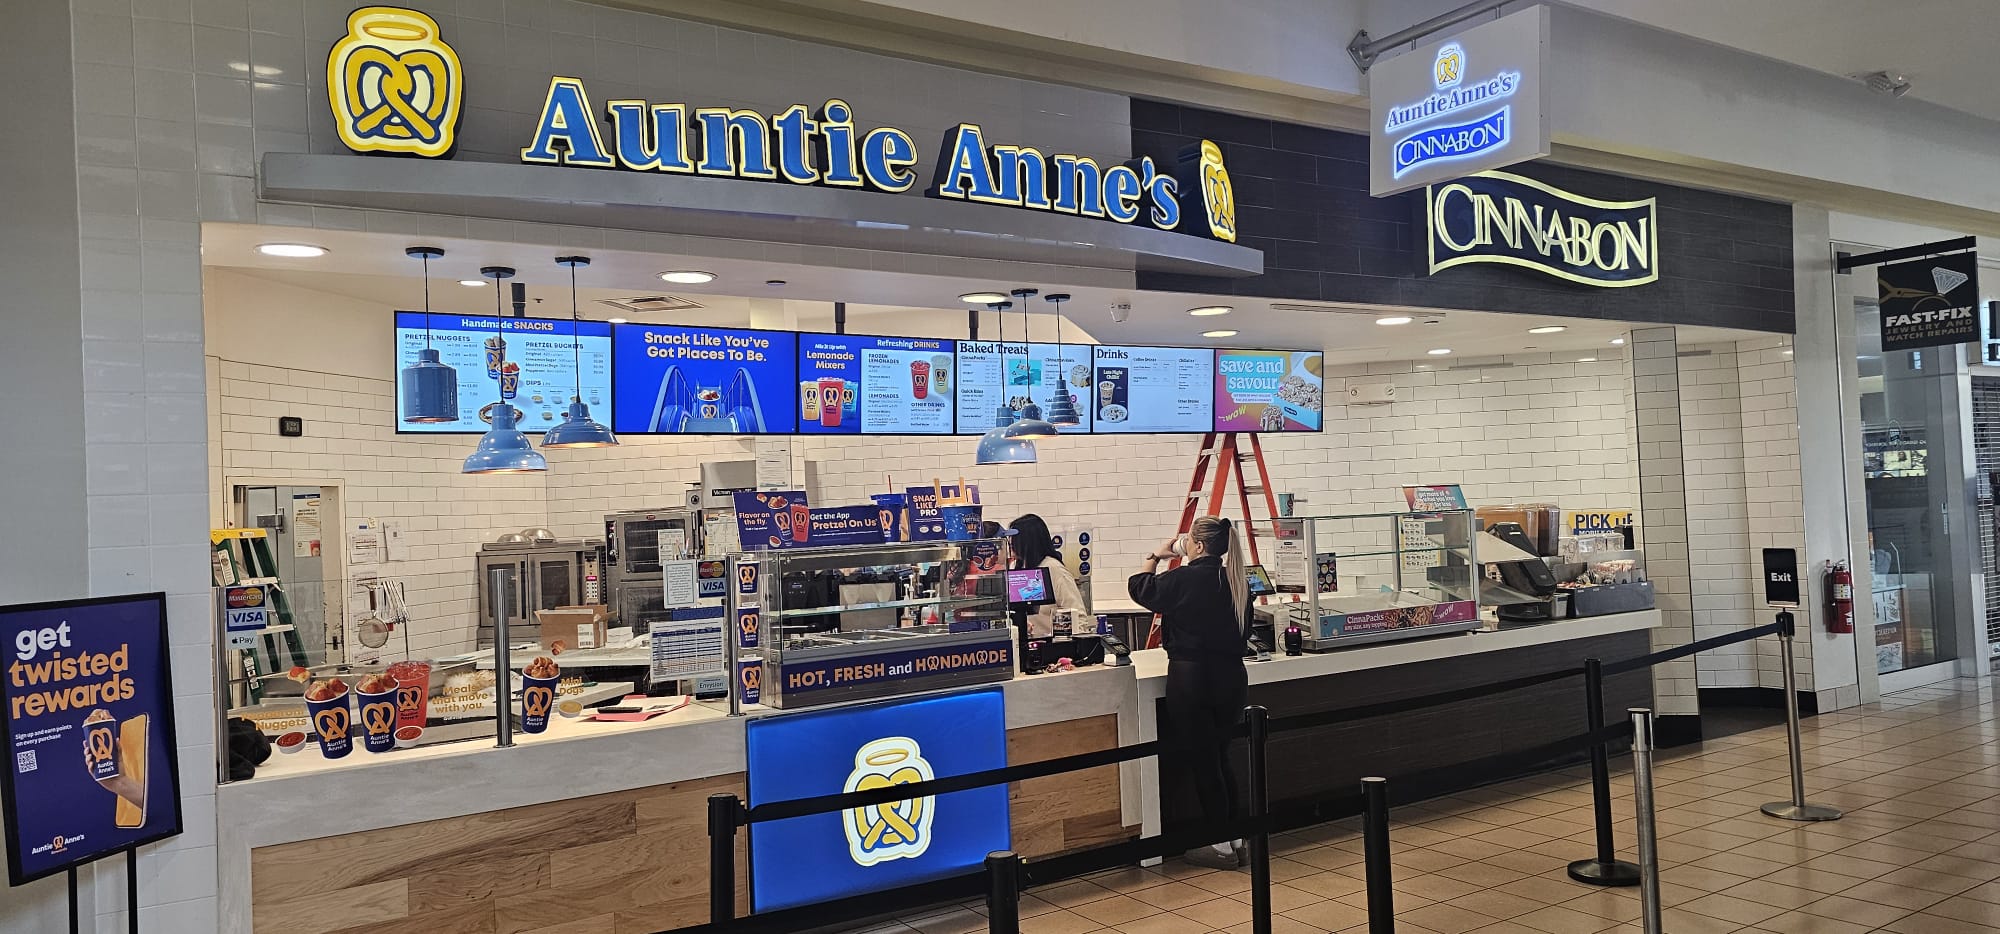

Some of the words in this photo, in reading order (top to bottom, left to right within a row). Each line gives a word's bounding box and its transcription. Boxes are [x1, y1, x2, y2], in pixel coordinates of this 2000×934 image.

[1388, 95, 1447, 128] Auntie
[1448, 75, 1512, 109] Anne's
[1398, 117, 1501, 165] CINNABON
[521, 76, 918, 193] Auntie
[938, 123, 1179, 230] Anne's
[1434, 183, 1647, 270] CINNABON
[461, 319, 513, 329] Handmade
[513, 321, 553, 331] SNACKS
[1885, 323, 1941, 335] JEWELRY
[1945, 319, 1973, 328] AND
[405, 333, 436, 341] PRETZL
[644, 331, 690, 345] Snack
[693, 334, 721, 346] Like
[724, 335, 769, 348] You've
[1886, 332, 1924, 342] WATCH
[1927, 326, 1973, 337] REPAIRS
[877, 339, 914, 349] Refreshing
[914, 341, 940, 349] DRINKS
[960, 342, 994, 354] Baked
[995, 343, 1029, 355] Treats
[646, 346, 675, 359] Got
[677, 347, 725, 360] Places
[727, 349, 743, 361] To
[746, 349, 767, 362] Be.
[806, 350, 855, 361] Lemonade
[1096, 348, 1129, 359] Drinks
[815, 361, 846, 370] Mixers
[1220, 360, 1254, 373] save
[1256, 357, 1284, 373] and
[1229, 377, 1278, 390] savour
[912, 494, 936, 502] SNAC
[916, 502, 934, 510] LIKE
[836, 512, 850, 520] App
[920, 508, 938, 517] PRO
[812, 520, 847, 530] Pretzel
[848, 519, 863, 528] On
[1575, 513, 1612, 529] PICK
[1770, 571, 1792, 583] Exit
[702, 581, 725, 591] VISA
[232, 611, 264, 623] VISA
[1346, 613, 1385, 624] CinnaPacks
[15, 620, 72, 661] get
[239, 637, 254, 645] Pay
[8, 643, 129, 687] twisted
[789, 669, 831, 687] HOT,
[834, 662, 885, 681] FRESH
[888, 661, 913, 677] and
[560, 676, 583, 687] Mini
[443, 684, 479, 695] Meals
[560, 687, 585, 696] Dogs
[11, 674, 135, 720] rewards
[432, 695, 457, 705] that
[459, 693, 489, 702] move
[435, 703, 460, 714] with
[462, 703, 485, 713] you.
[255, 718, 308, 731] Nuggets
[15, 731, 27, 741] Sign
[27, 731, 34, 739] up
[34, 728, 44, 736] and
[56, 724, 73, 733] points
[23, 738, 38, 747] every
[38, 733, 62, 744] purchase
[326, 739, 347, 748] Auntie
[327, 744, 347, 752] Anne's
[97, 761, 114, 769] Auntie
[31, 843, 53, 855] Auntie
[64, 834, 85, 845] Anne's
